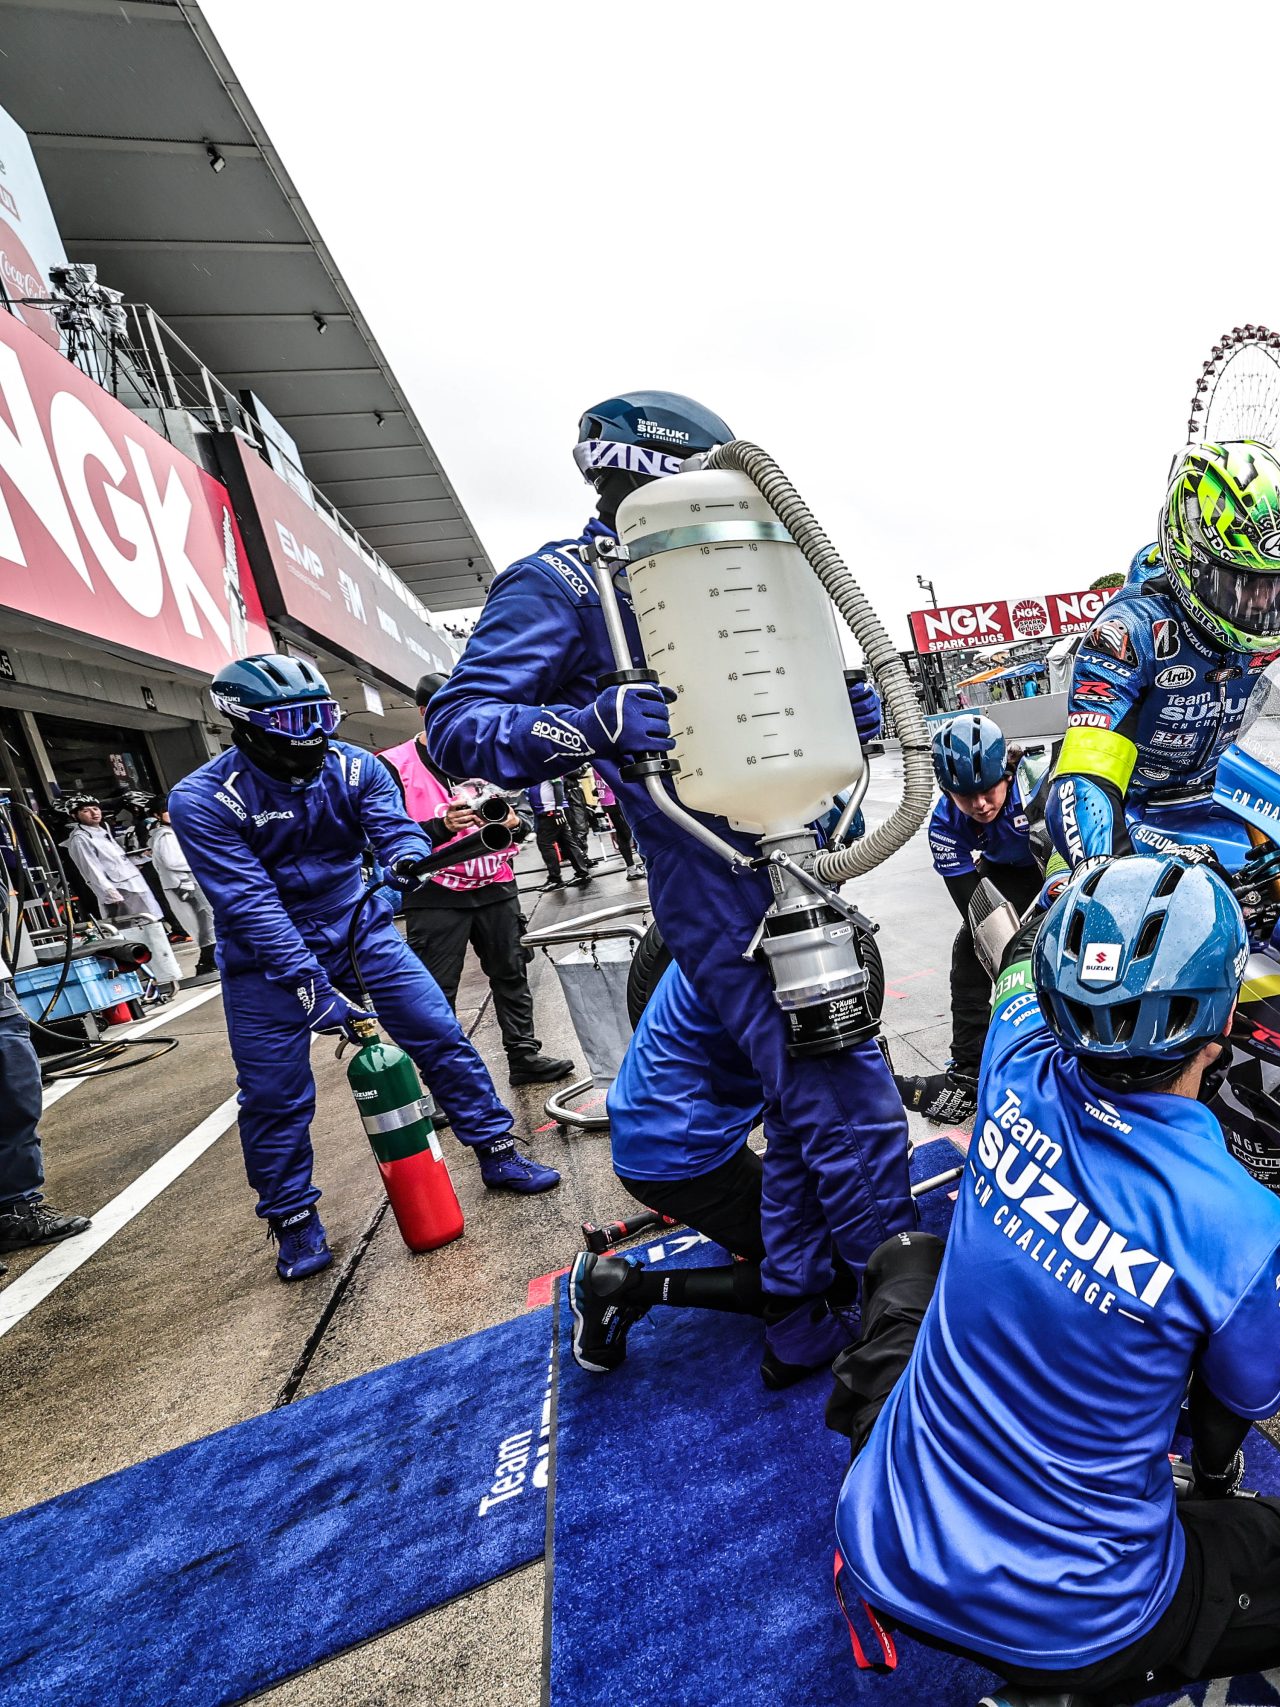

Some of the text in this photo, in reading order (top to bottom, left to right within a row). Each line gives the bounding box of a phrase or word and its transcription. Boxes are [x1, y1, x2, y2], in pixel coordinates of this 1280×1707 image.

[637, 418, 658, 428] Team
[637, 424, 689, 441] SUZUKI
[0, 341, 232, 657] NGK
[738, 501, 749, 510] 0G
[690, 504, 701, 513] 0G
[700, 546, 710, 555] 1G
[748, 543, 758, 552] 1G
[1203, 525, 1235, 561] SDG
[709, 588, 720, 598] 2G
[757, 584, 767, 593] 2G
[1016, 607, 1041, 619] NGK
[766, 624, 776, 634] 3G
[924, 604, 1001, 640] NGK
[718, 629, 729, 639] 3G
[1180, 620, 1213, 658] SUZUKI
[929, 633, 1005, 651] SPARK PLUGS
[727, 672, 738, 682] 4G
[775, 666, 786, 675] 4G
[1163, 667, 1191, 683] Arai
[1167, 691, 1211, 706] Team
[784, 707, 795, 717] 5G
[1159, 697, 1247, 722] SUZU
[736, 714, 747, 724] 5G
[746, 756, 757, 765] 6G
[793, 749, 804, 758] 6G
[1232, 788, 1251, 807] CN
[255, 811, 295, 828] SUZUKI
[1060, 780, 1087, 868] SUZUK
[464, 850, 518, 878] VIDE
[1084, 1101, 1134, 1136] TAICHI
[993, 1088, 1063, 1169] Team
[978, 1119, 1175, 1308] SUZUKI
[974, 1175, 1117, 1315] CN CHALLENGE
[478, 1429, 533, 1517] Team
